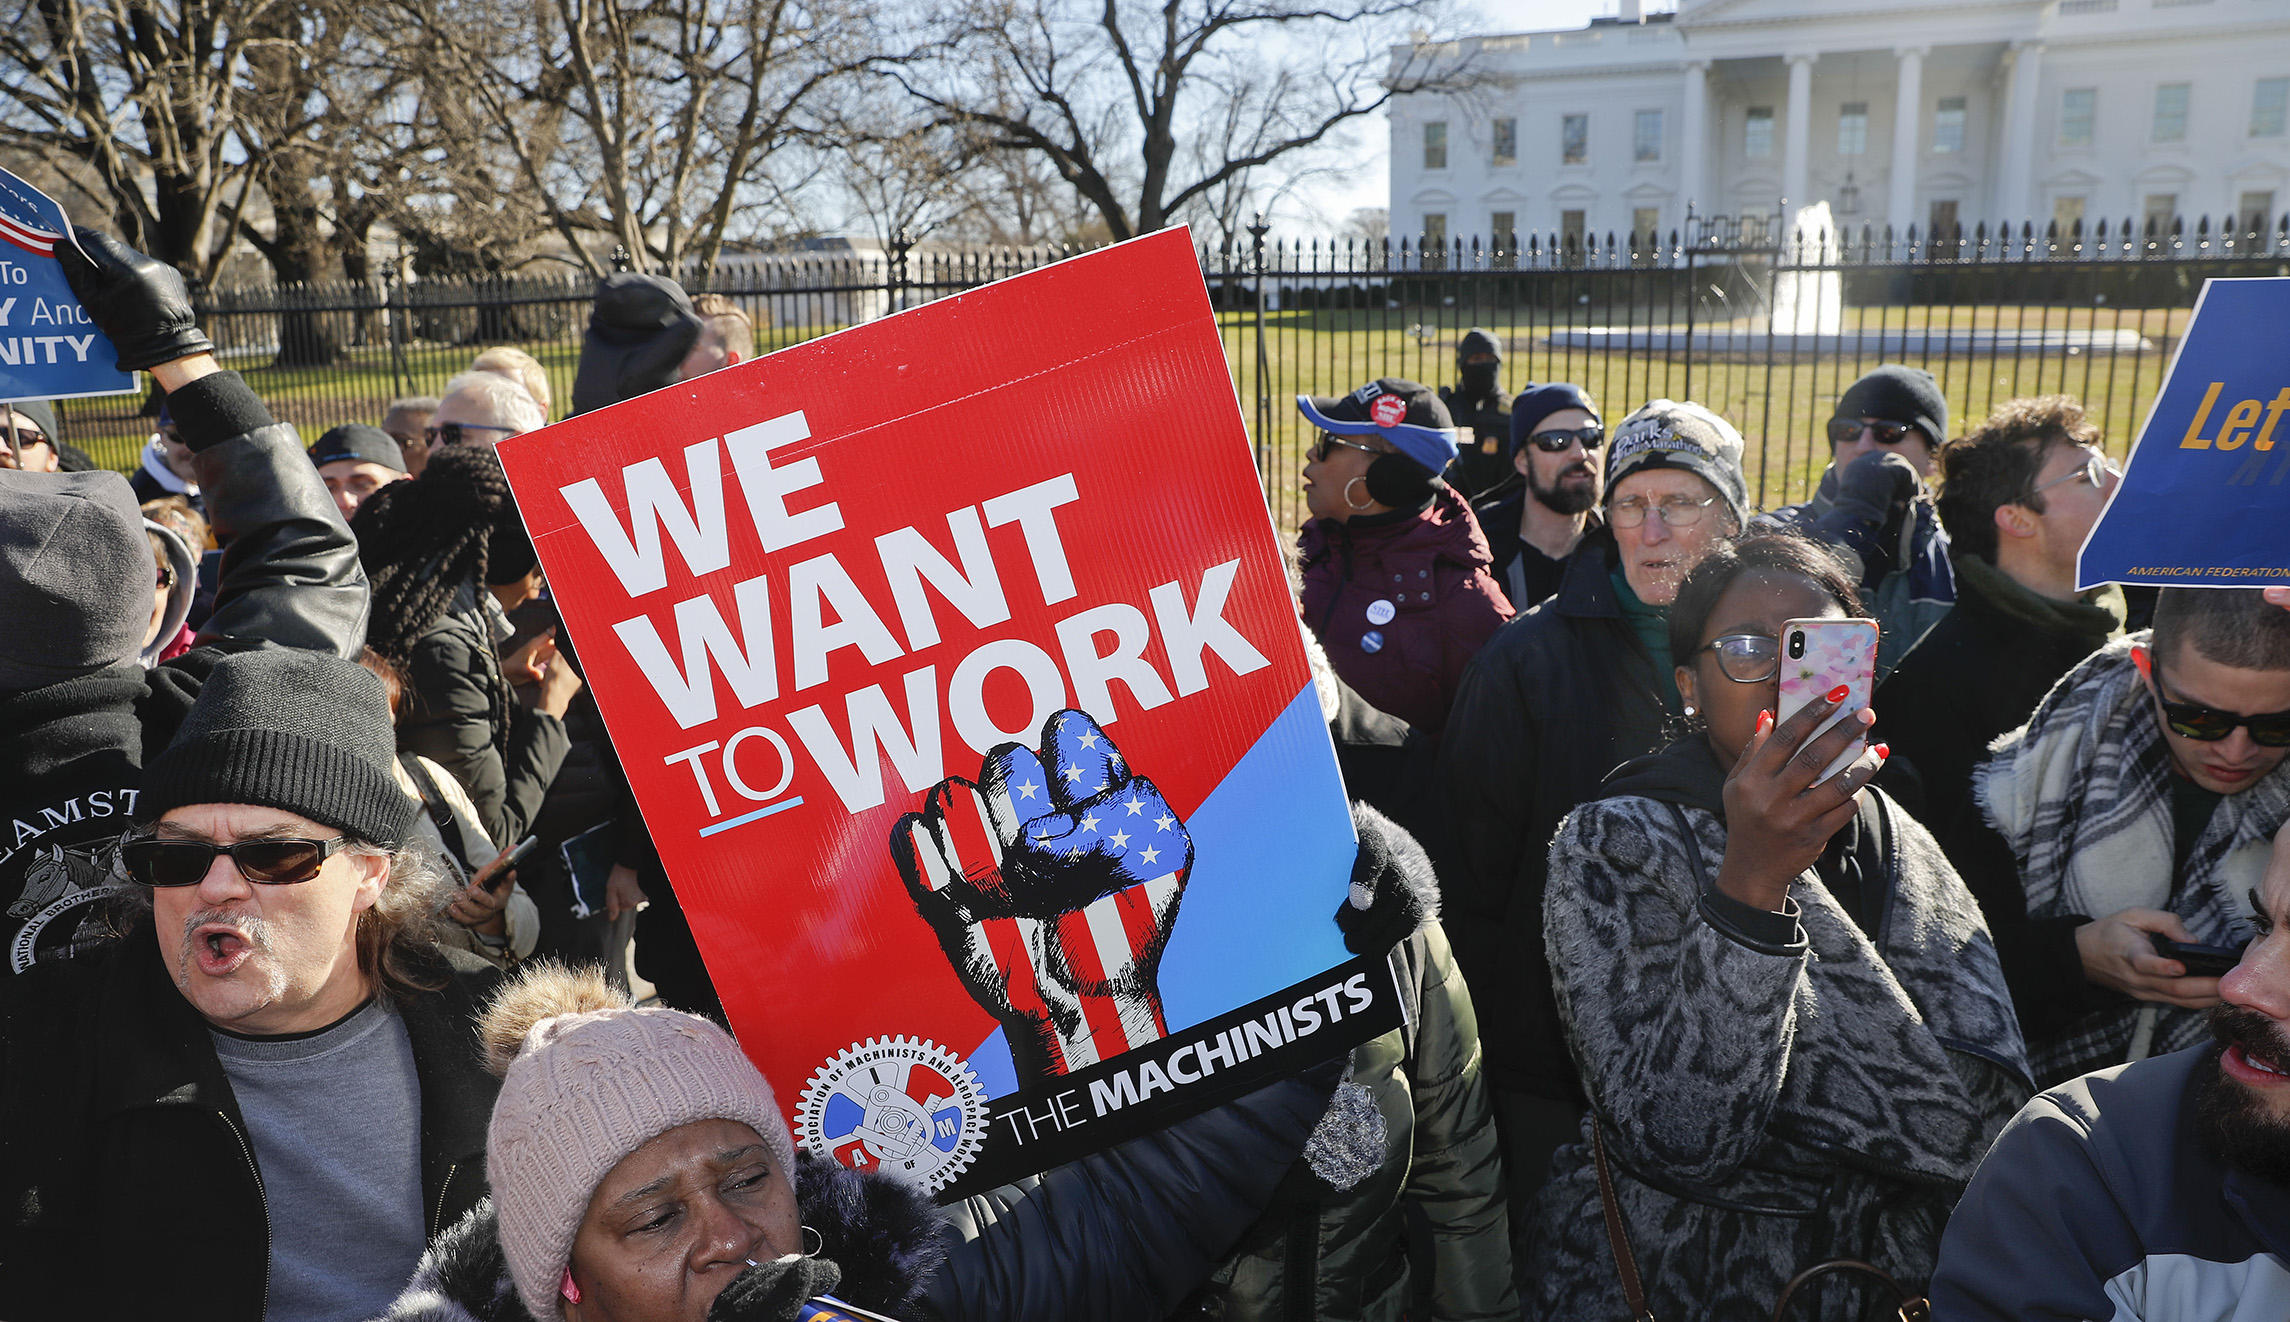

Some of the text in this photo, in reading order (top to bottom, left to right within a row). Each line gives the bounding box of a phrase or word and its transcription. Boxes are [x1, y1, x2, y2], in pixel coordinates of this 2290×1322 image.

[0, 261, 28, 285] To
[1612, 425, 1673, 463] Parks
[558, 409, 845, 598] WE
[2127, 566, 2290, 577] AMERICAN FEDERATION
[611, 472, 1079, 730] WANT
[664, 558, 1271, 816] TO WORK
[0, 789, 140, 864] AMST
[17, 920, 45, 970] NATIONAL
[829, 1070, 844, 1082] OF
[844, 1048, 926, 1071] MACHINISTS
[928, 1056, 952, 1075] AND
[995, 972, 1373, 1146] THE MACHINISTS
[950, 1073, 977, 1135] AEROSPACE
[852, 1117, 958, 1171] A OF M
[928, 1138, 973, 1183] WORKERS
